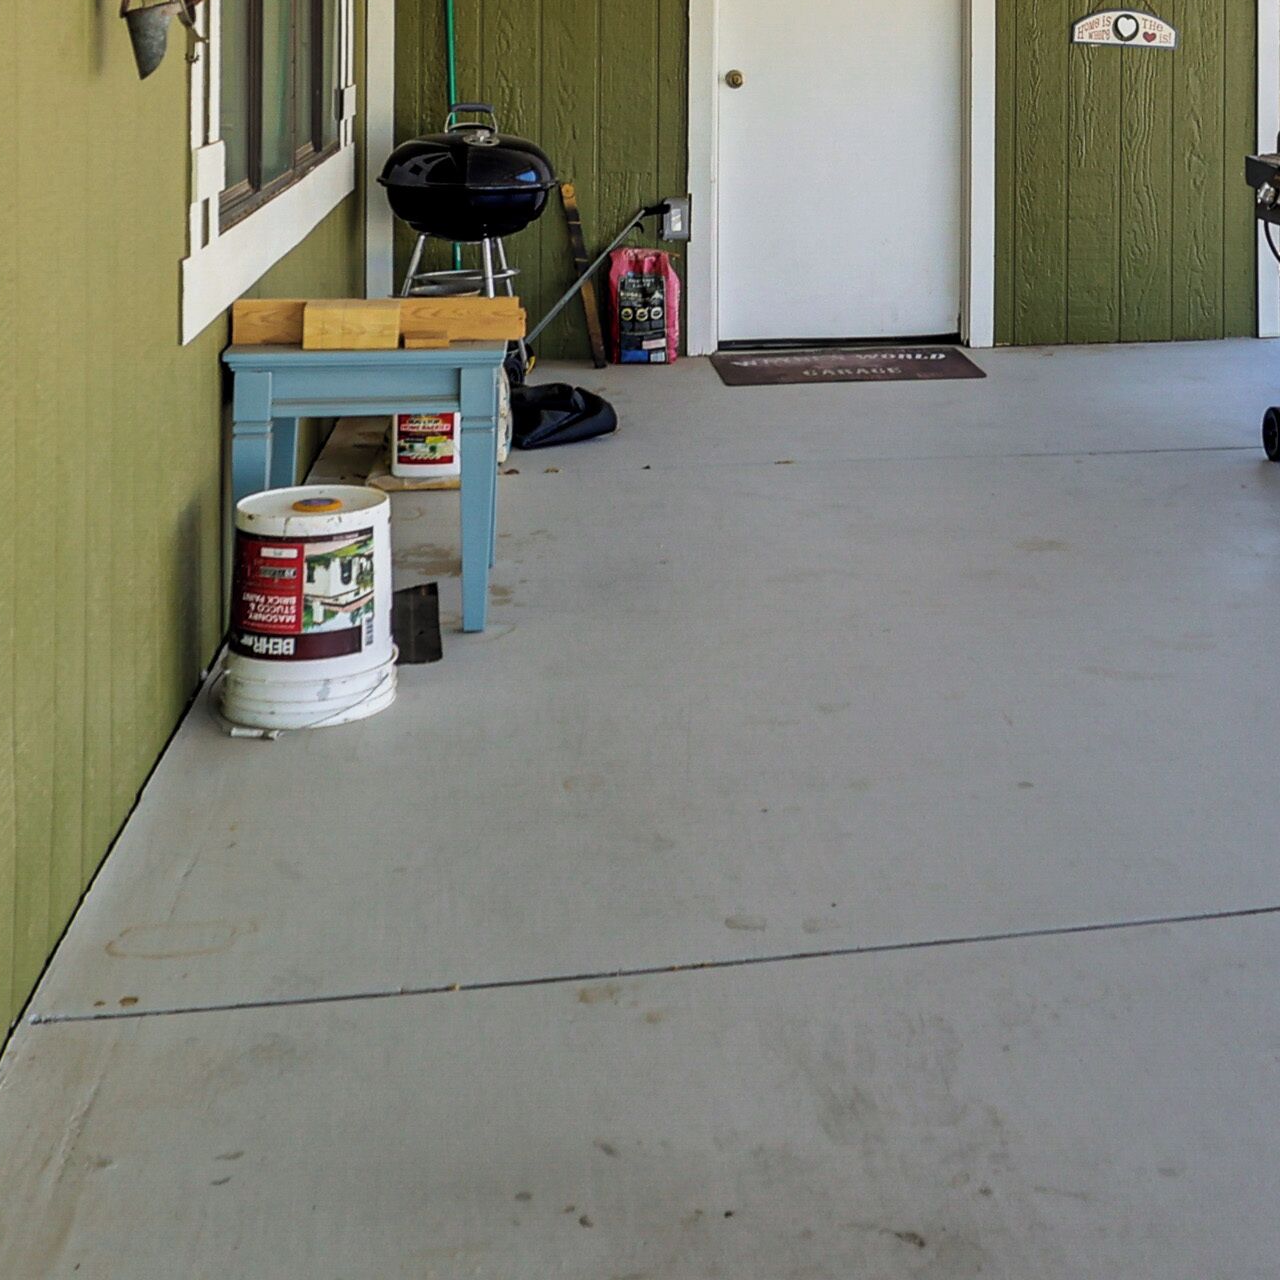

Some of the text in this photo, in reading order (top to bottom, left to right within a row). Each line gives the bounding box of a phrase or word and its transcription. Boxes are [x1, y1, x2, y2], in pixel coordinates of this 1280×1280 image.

[802, 367, 902, 376] GARAGE
[266, 595, 297, 606] BRICK
[257, 603, 297, 615] STUCCO
[253, 637, 295, 655] BEHR
